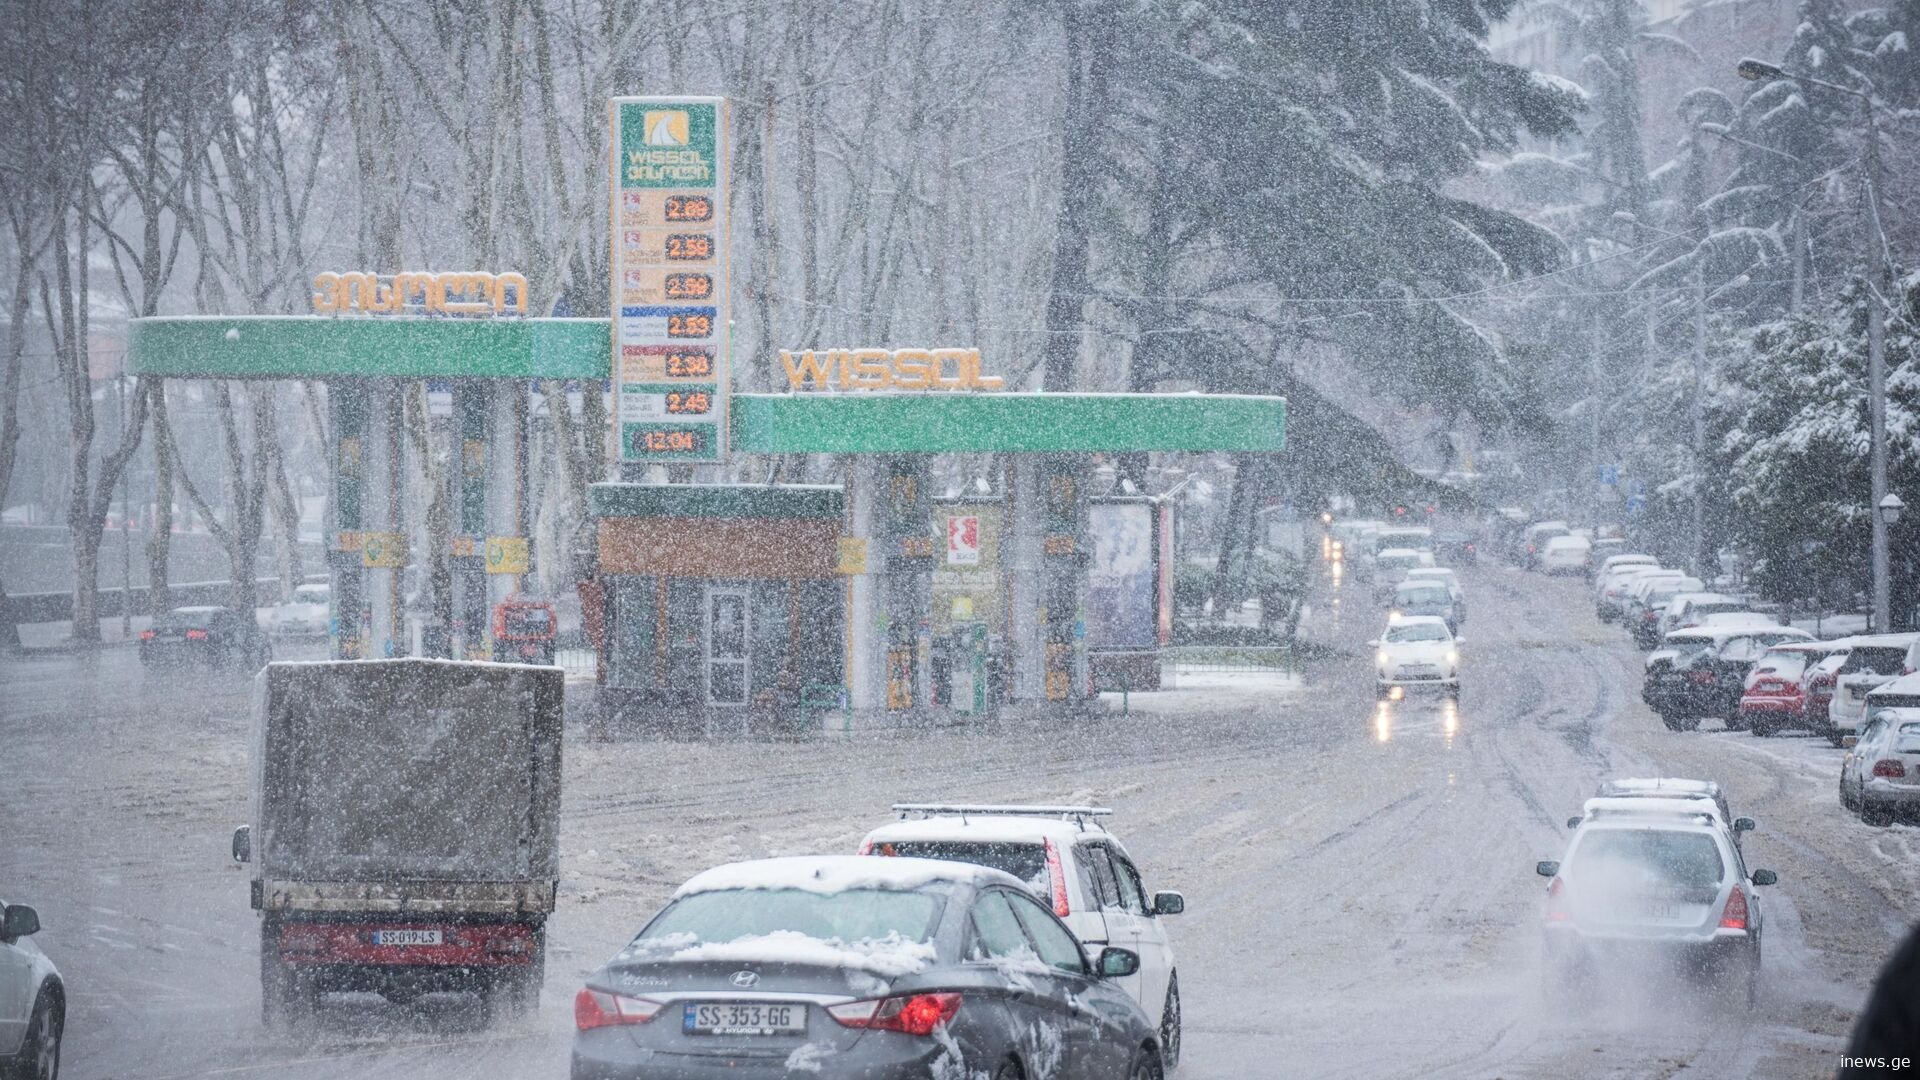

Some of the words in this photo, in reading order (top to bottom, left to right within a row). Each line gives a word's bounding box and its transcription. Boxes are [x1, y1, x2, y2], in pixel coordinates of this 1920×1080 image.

[628, 151, 710, 164] WISSOL
[314, 271, 527, 314] ვისოლი
[779, 349, 1004, 389] WISSOL
[382, 931, 435, 944] SS-019-LS
[698, 1005, 791, 1027] SS-353-GG
